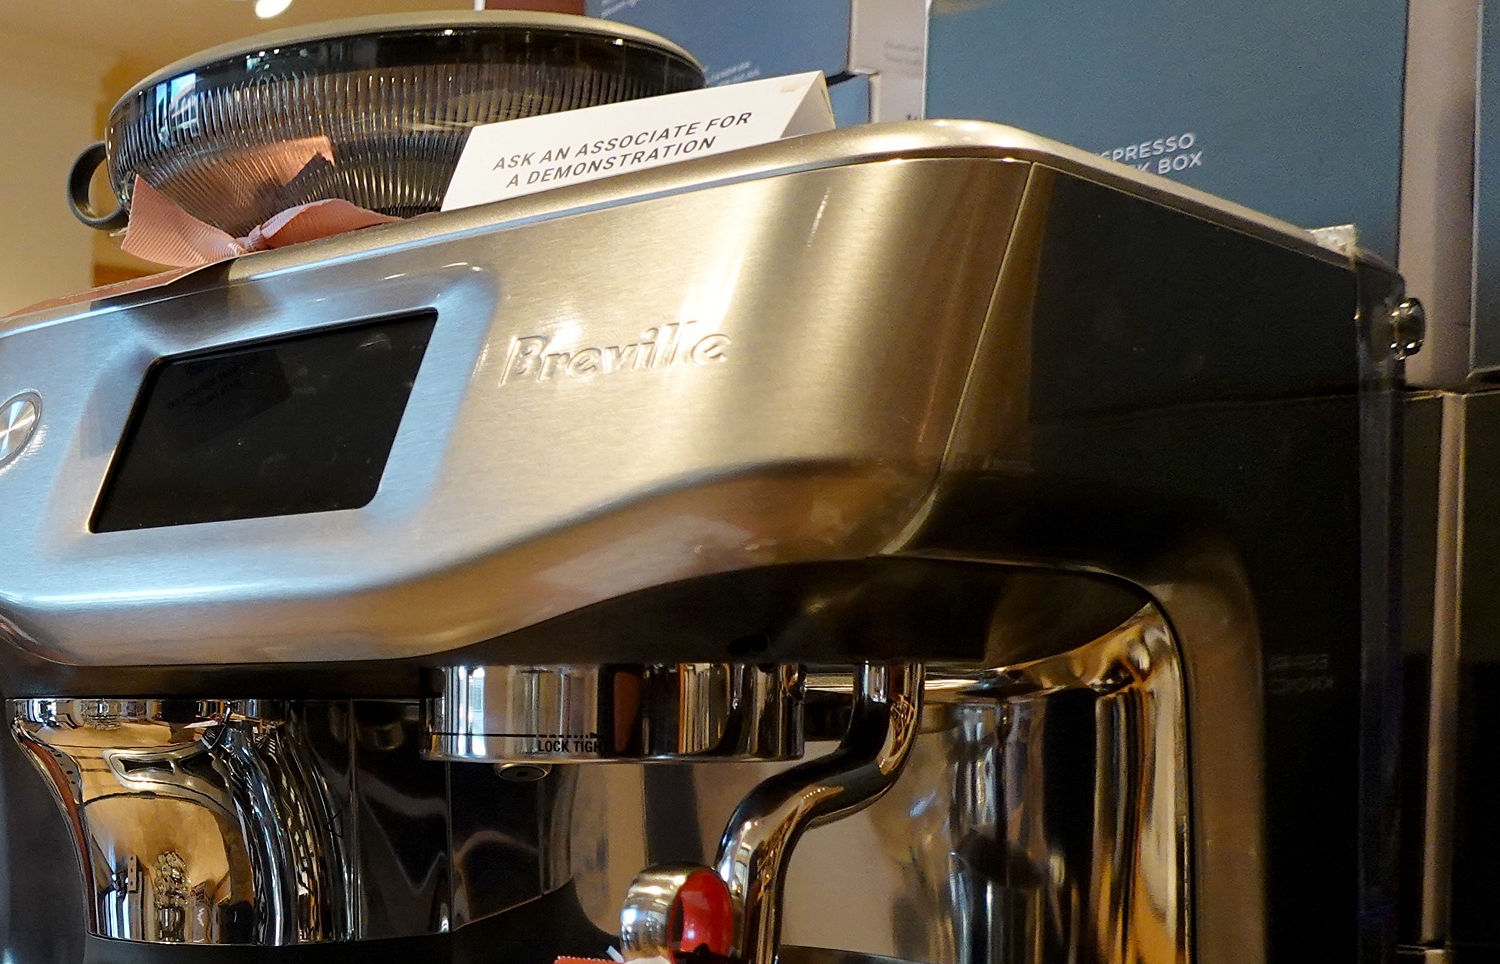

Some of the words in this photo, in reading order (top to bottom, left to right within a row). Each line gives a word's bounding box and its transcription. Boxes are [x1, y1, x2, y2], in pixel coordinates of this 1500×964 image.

[492, 152, 533, 171] ASK
[538, 146, 572, 165] AN
[575, 122, 702, 156] ASSOCIATE
[705, 111, 753, 132] FOR
[505, 173, 520, 188] A
[526, 136, 717, 186] DEMONSTRATION
[1158, 150, 1203, 175] BOX
[498, 320, 732, 387] Breville
[538, 740, 572, 753] LOCK
